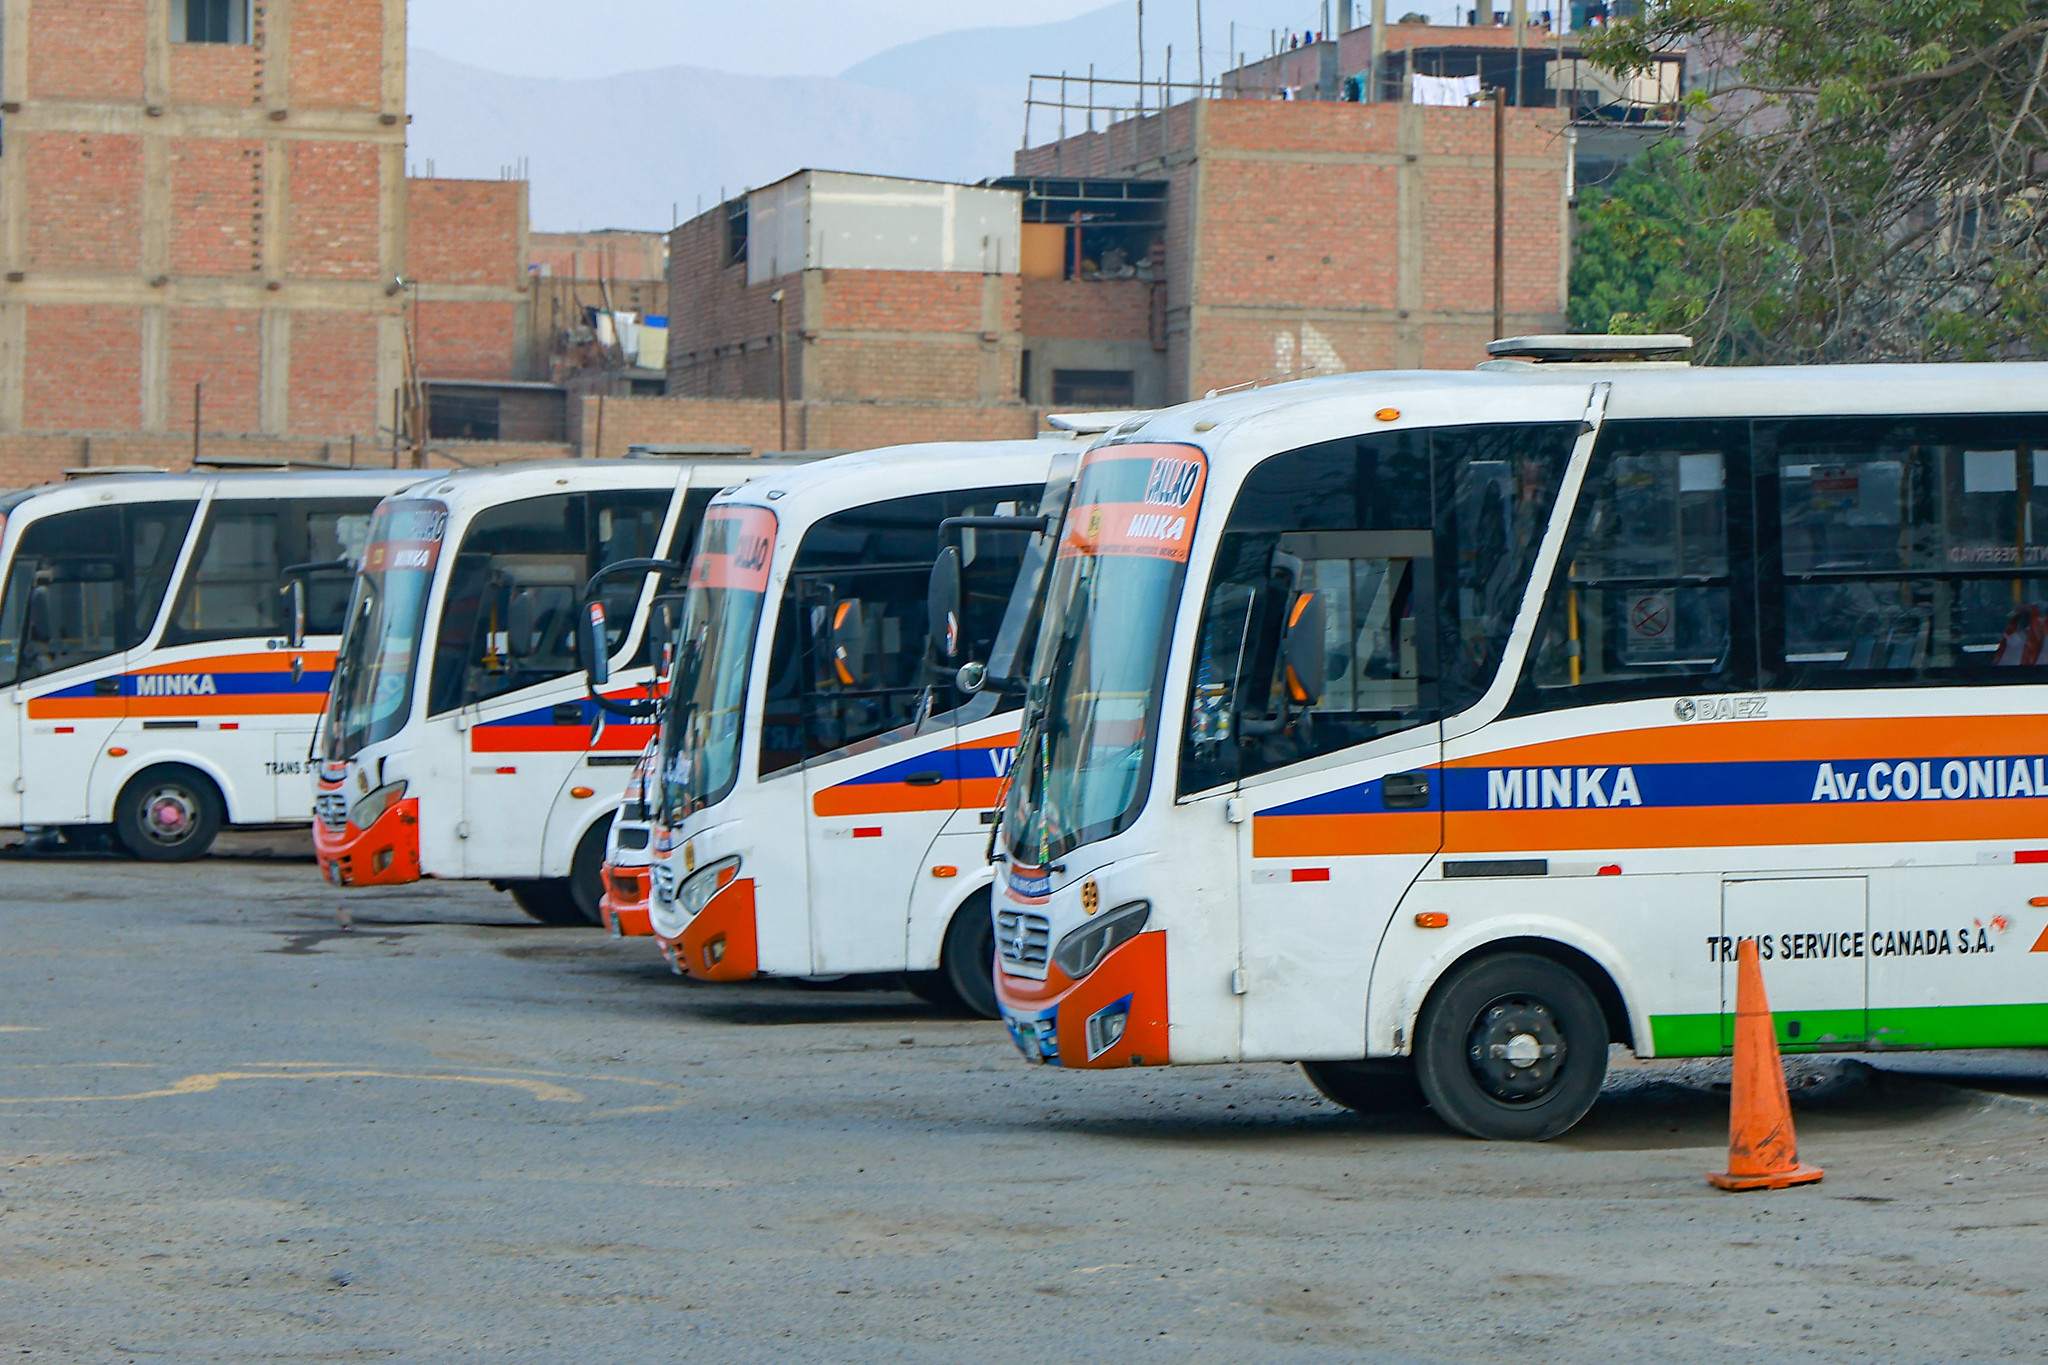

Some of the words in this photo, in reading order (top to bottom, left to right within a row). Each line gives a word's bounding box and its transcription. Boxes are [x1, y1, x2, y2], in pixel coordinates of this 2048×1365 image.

[1127, 513, 1187, 540] MINKA
[136, 673, 218, 697] MINKA
[1697, 696, 1768, 720] BAEZ
[1487, 766, 1643, 810] MINKA
[1780, 932, 1863, 959] SERVICE
[1871, 929, 1951, 956] CANADA
[1957, 927, 1995, 954] S.A.
